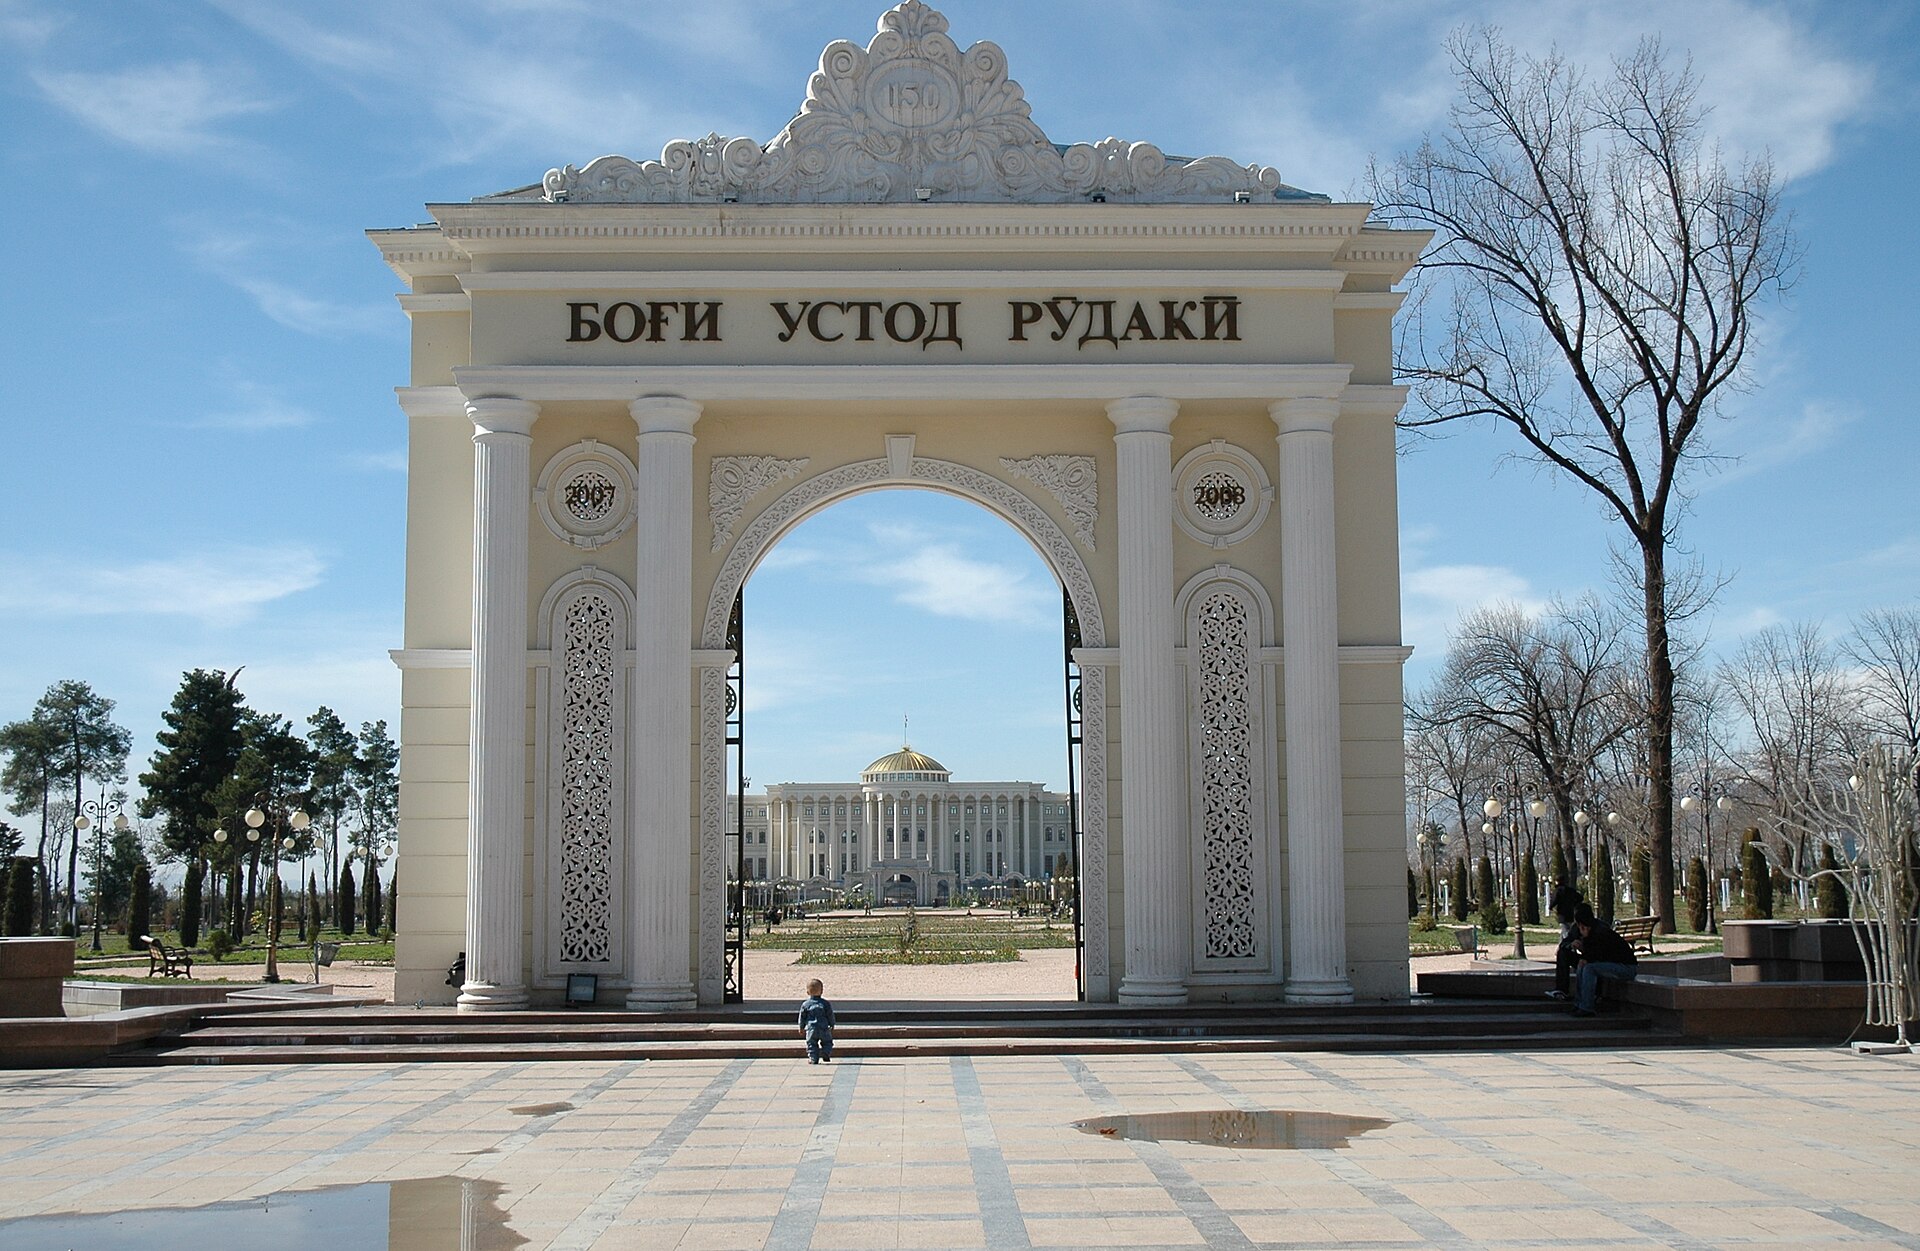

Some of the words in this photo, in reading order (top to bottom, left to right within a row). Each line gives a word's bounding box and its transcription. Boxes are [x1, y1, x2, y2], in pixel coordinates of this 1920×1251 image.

[565, 301, 724, 343] БОҒИ
[770, 301, 963, 351] УСТОД
[1007, 295, 1243, 351] РӮДАКӢ
[1193, 486, 1246, 505] 2008
